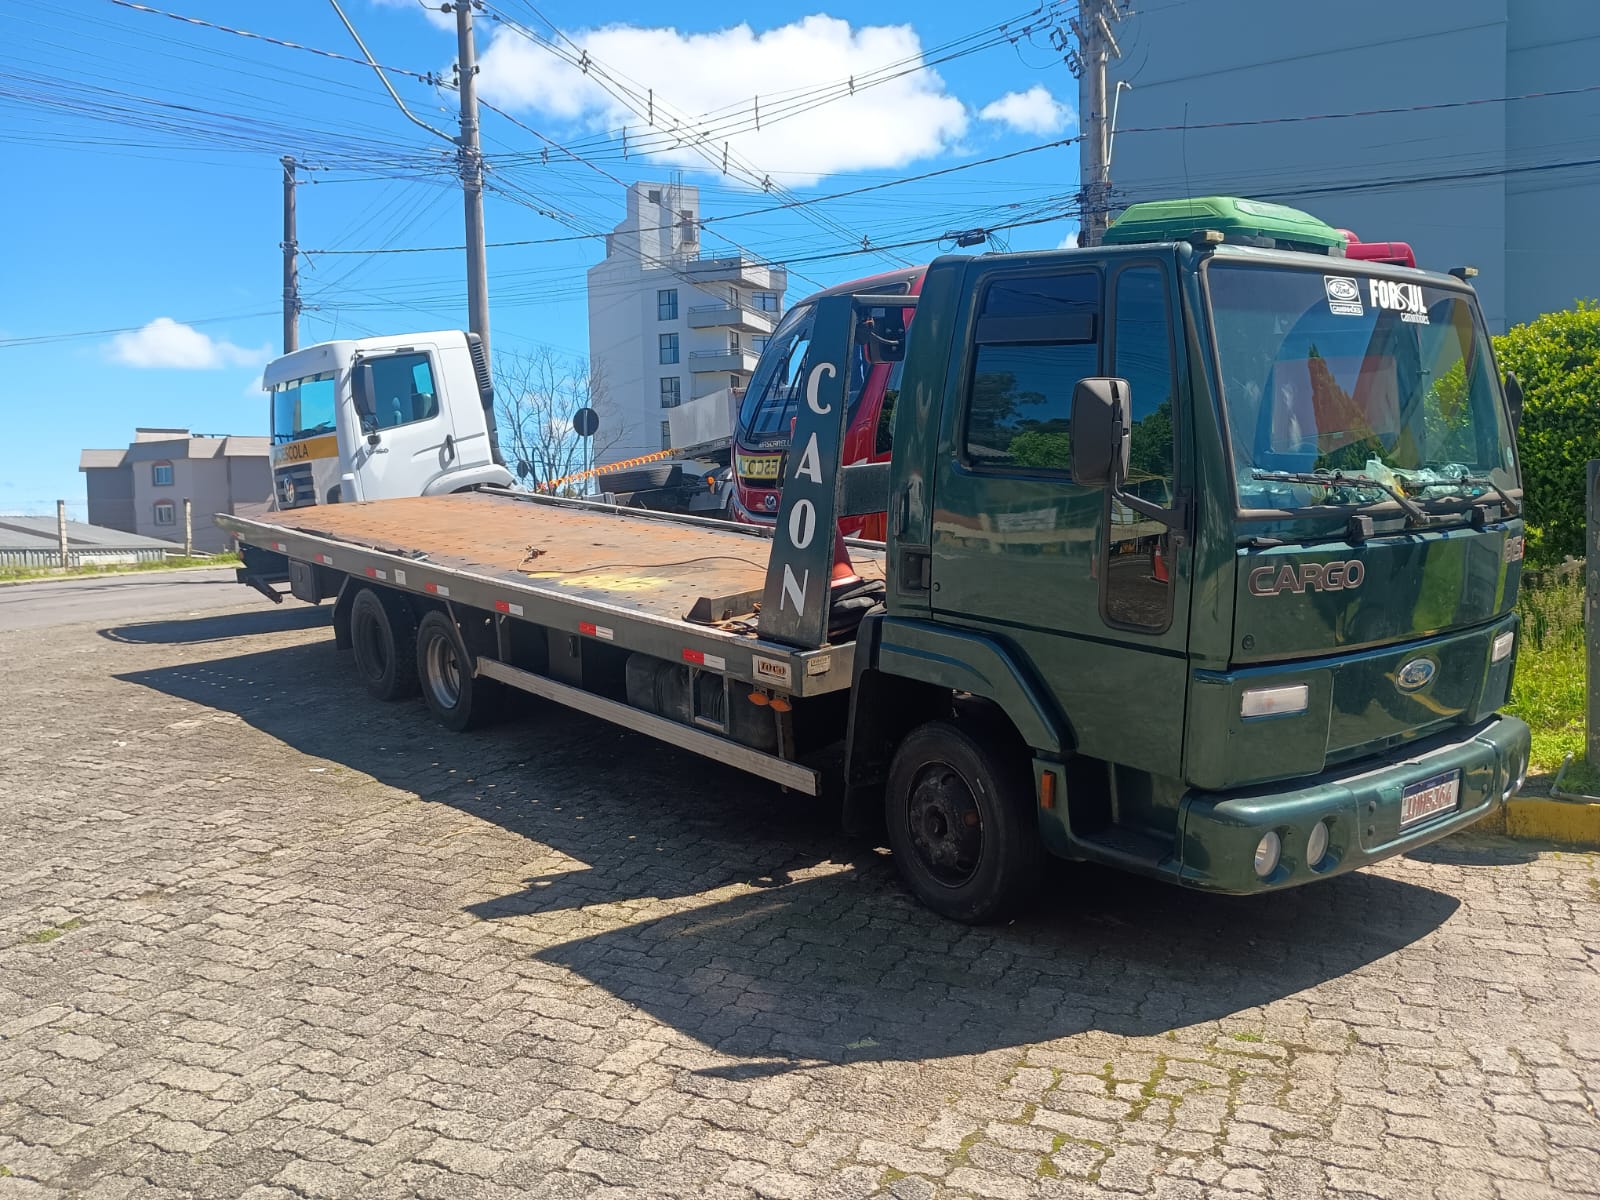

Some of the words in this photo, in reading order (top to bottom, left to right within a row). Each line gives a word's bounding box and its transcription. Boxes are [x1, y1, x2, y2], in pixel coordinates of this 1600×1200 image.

[1369, 278, 1428, 314] FORSUL
[780, 362, 837, 617] CAON
[1248, 559, 1365, 597] CARGO
